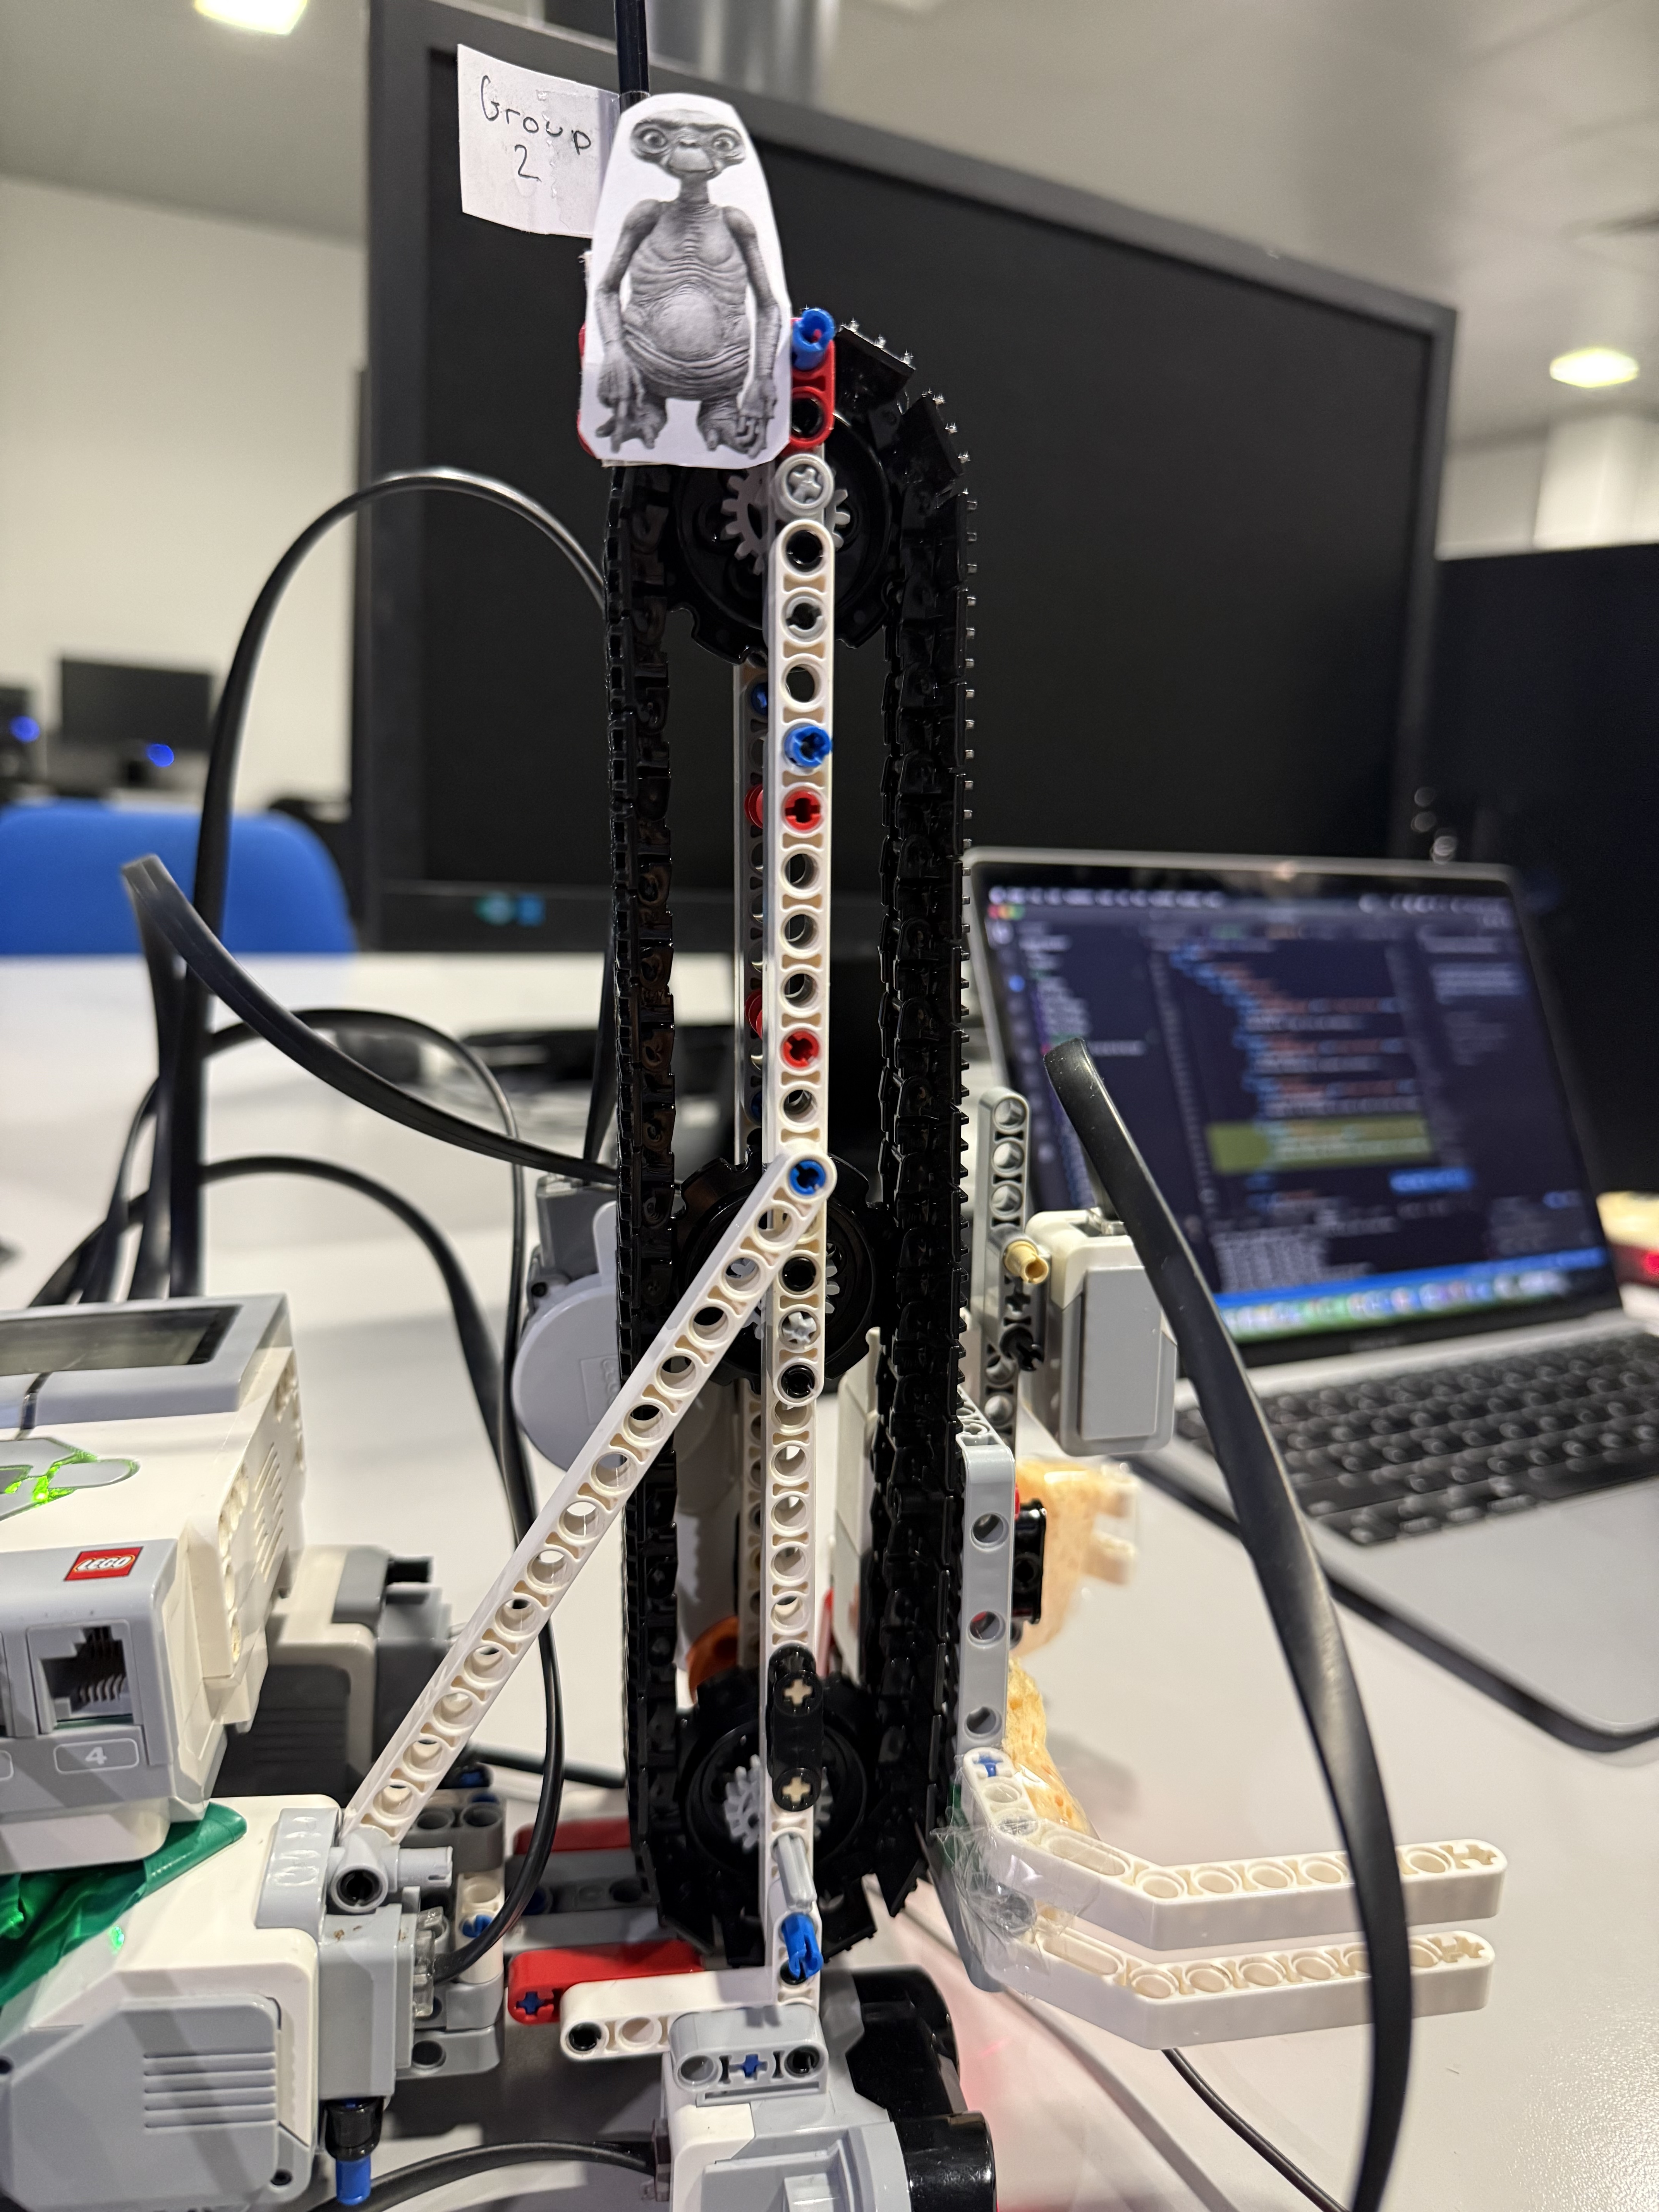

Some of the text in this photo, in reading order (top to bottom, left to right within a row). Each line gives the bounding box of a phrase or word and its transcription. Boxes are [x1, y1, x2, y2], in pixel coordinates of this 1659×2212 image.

[480, 75, 592, 155] Group
[514, 144, 542, 182] 2
[74, 1555, 134, 1571] LEGO
[85, 1746, 107, 1765] 4
